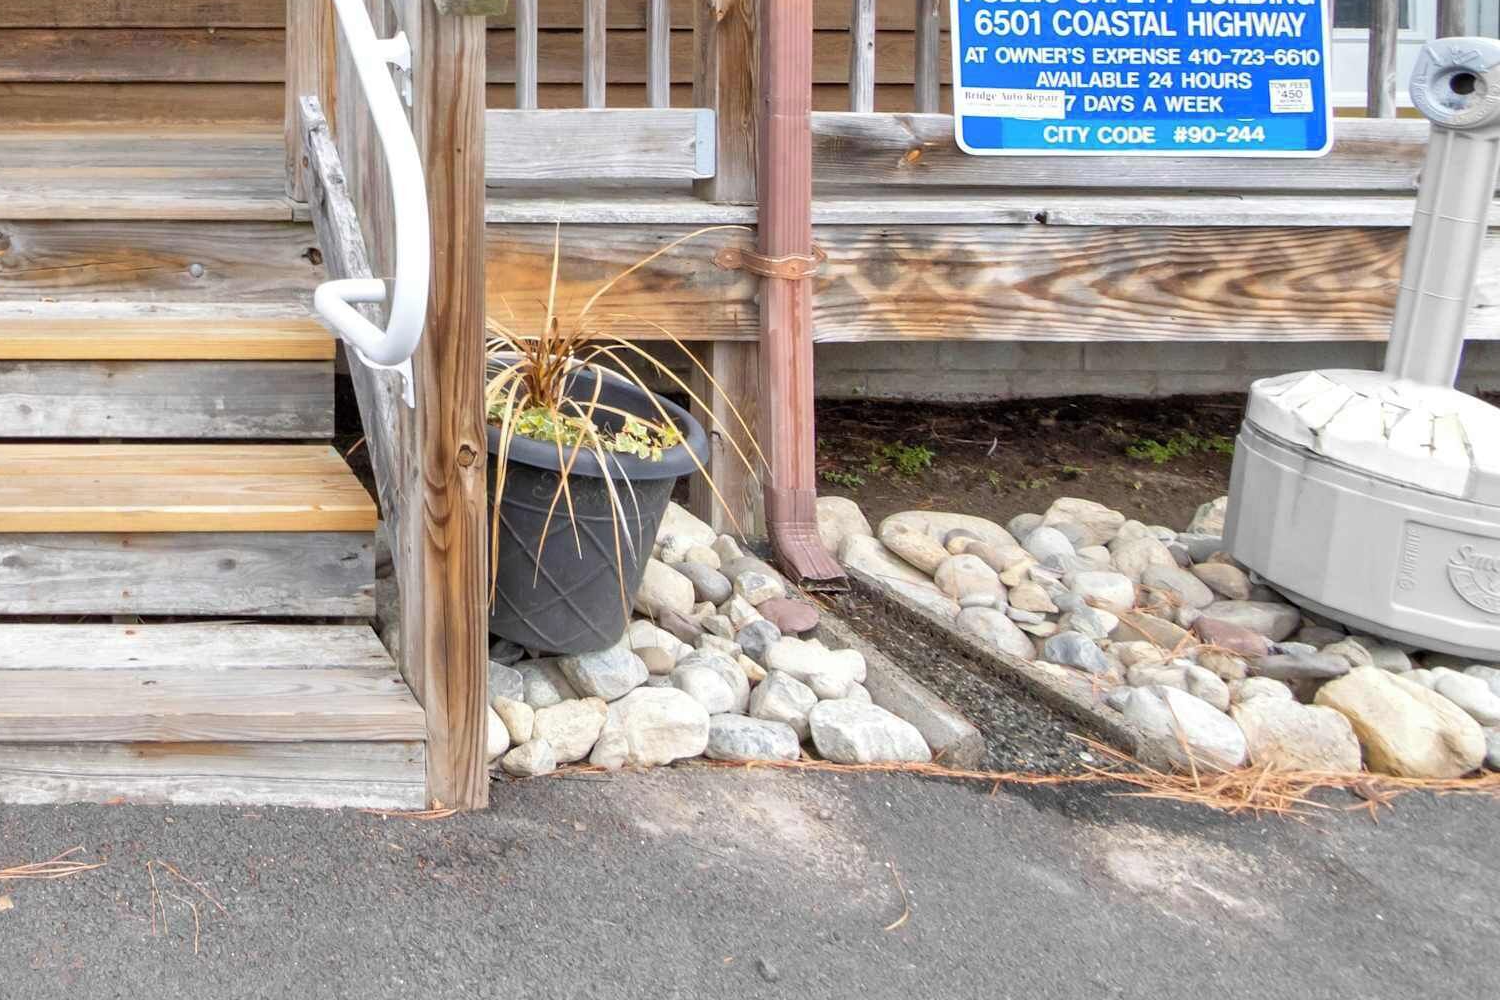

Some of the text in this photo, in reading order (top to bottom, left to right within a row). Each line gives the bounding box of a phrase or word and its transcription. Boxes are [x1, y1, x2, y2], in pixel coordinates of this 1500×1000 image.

[974, 10, 1306, 37] 6501 COASTAL HIGHWAY
[964, 47, 1320, 66] AT OWNER'S EXPENSE 410-723-6610
[1035, 72, 1253, 89] AVAILABLE 24 HOURS
[965, 91, 1060, 103] Bridge Auto Repair
[1065, 96, 1224, 113] 7 DAYS A WEEK
[1043, 126, 1265, 144] CITY CODE #90-244
